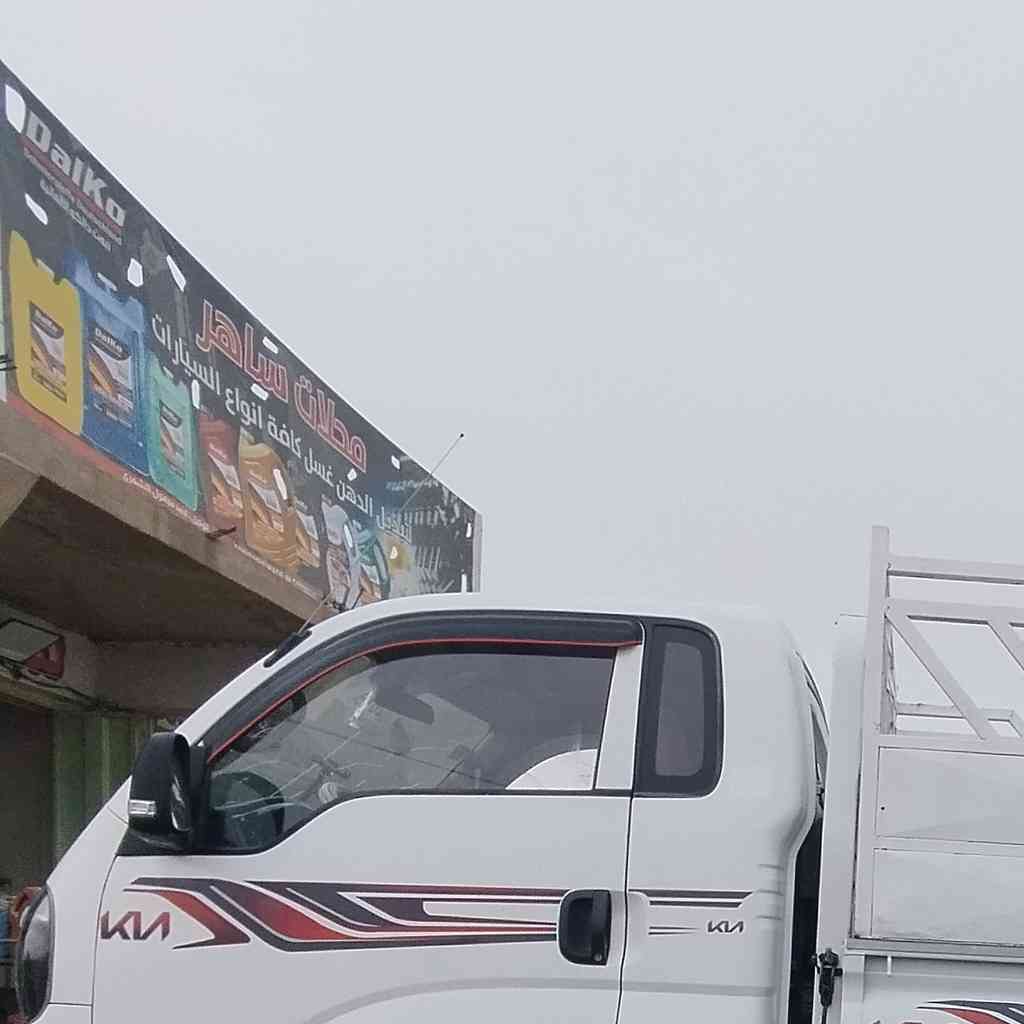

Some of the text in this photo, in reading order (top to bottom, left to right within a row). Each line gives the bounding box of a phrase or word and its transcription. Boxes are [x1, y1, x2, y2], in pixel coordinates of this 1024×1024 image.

[26, 110, 126, 227] DalKo
[152, 313, 220, 396] السيارات
[196, 299, 367, 473] محلات ساهر
[225, 388, 262, 429] انواع
[267, 414, 301, 459] كافة
[100, 910, 170, 941] KIA
[707, 920, 744, 934] KIA
